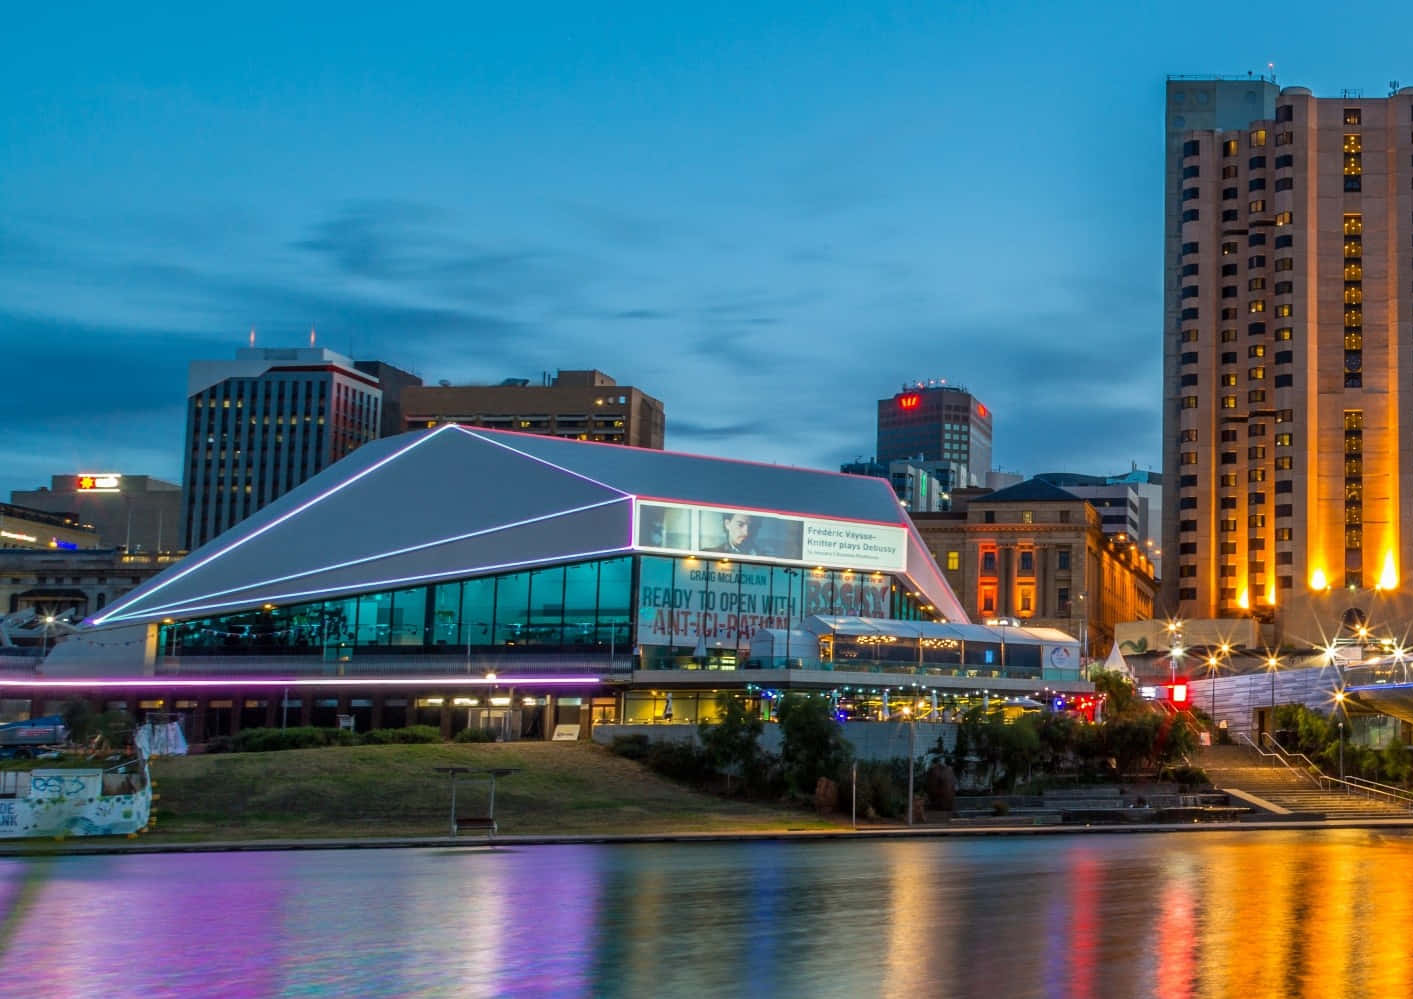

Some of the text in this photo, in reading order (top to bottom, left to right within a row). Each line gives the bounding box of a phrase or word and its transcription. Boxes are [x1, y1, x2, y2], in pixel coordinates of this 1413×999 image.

[839, 542, 861, 551] plays
[690, 570, 716, 582] CRAIG
[643, 586, 693, 609] READY
[700, 591, 716, 611] TO
[719, 592, 757, 614] OPEN
[762, 594, 797, 616] WITH
